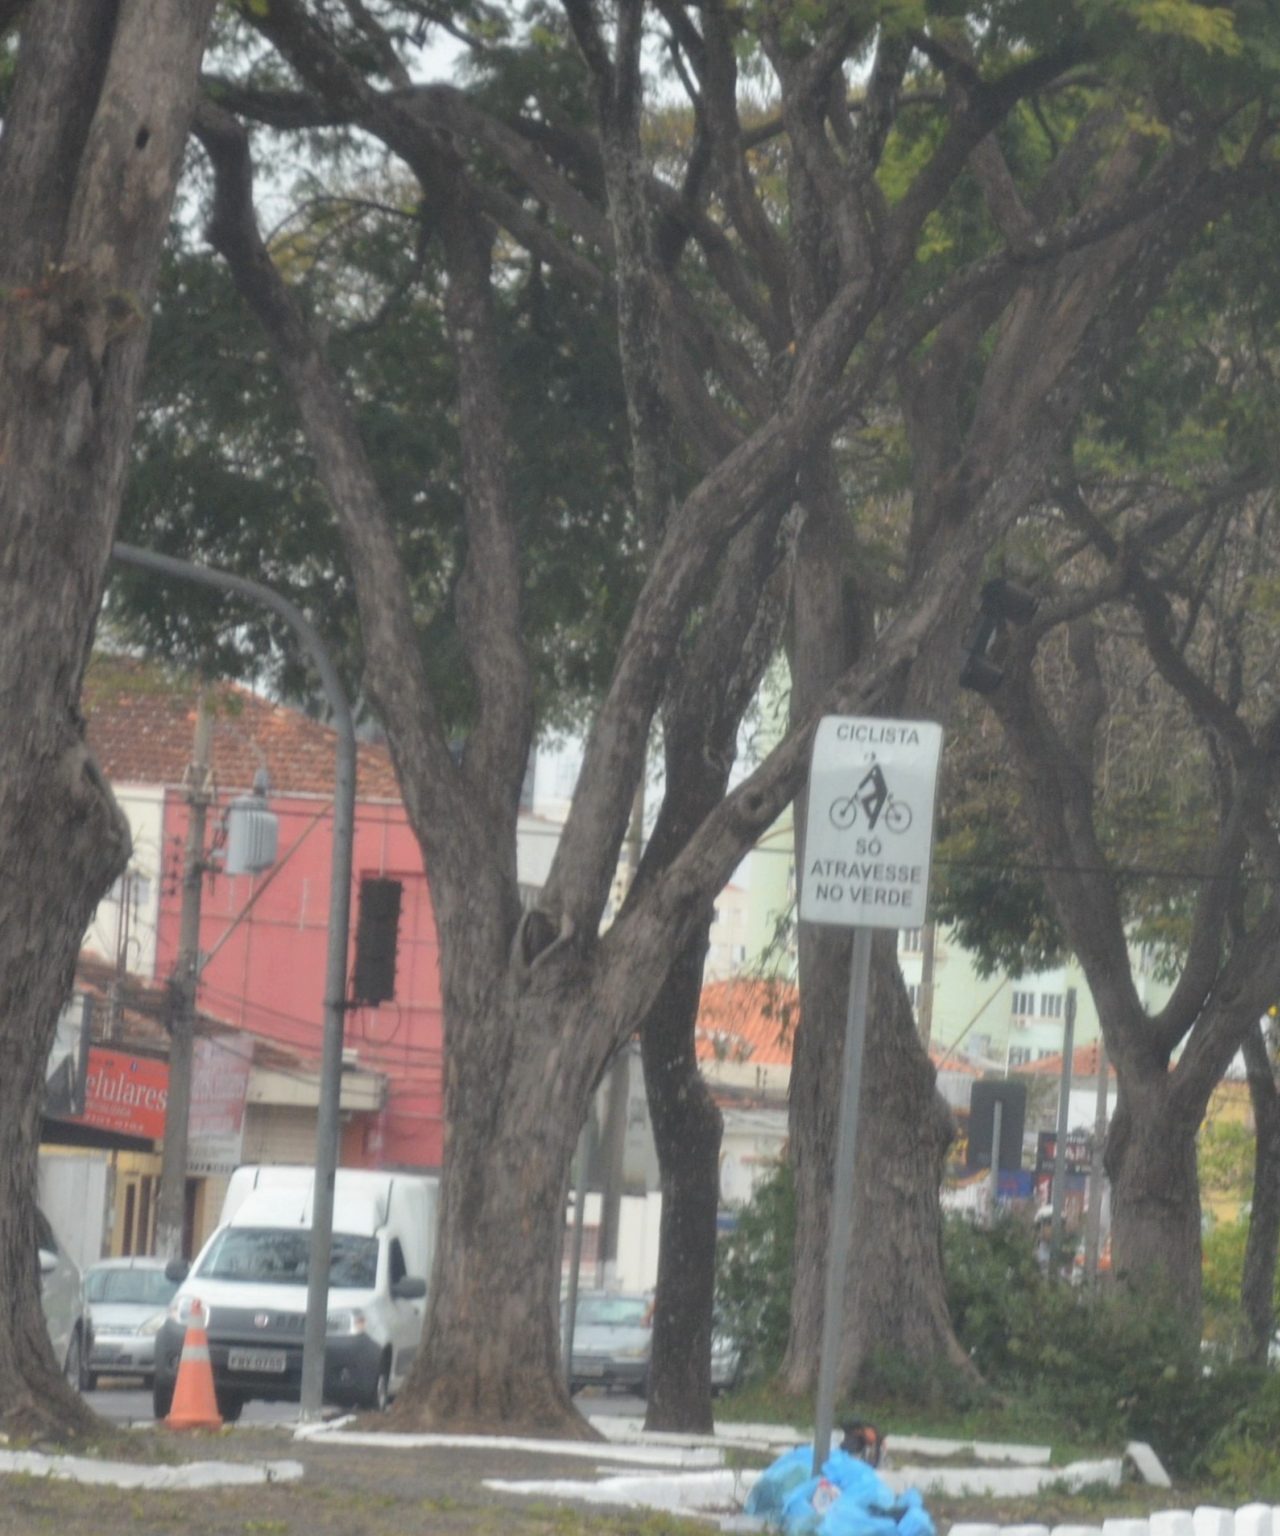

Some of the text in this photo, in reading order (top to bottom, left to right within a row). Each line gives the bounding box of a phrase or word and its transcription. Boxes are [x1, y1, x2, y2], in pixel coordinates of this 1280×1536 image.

[836, 723, 919, 745] CICLISTA
[856, 836, 882, 857] SÓ
[811, 860, 922, 884] ATRAVESSE
[815, 884, 913, 907] NO VERDE
[85, 1068, 168, 1111] elulares
